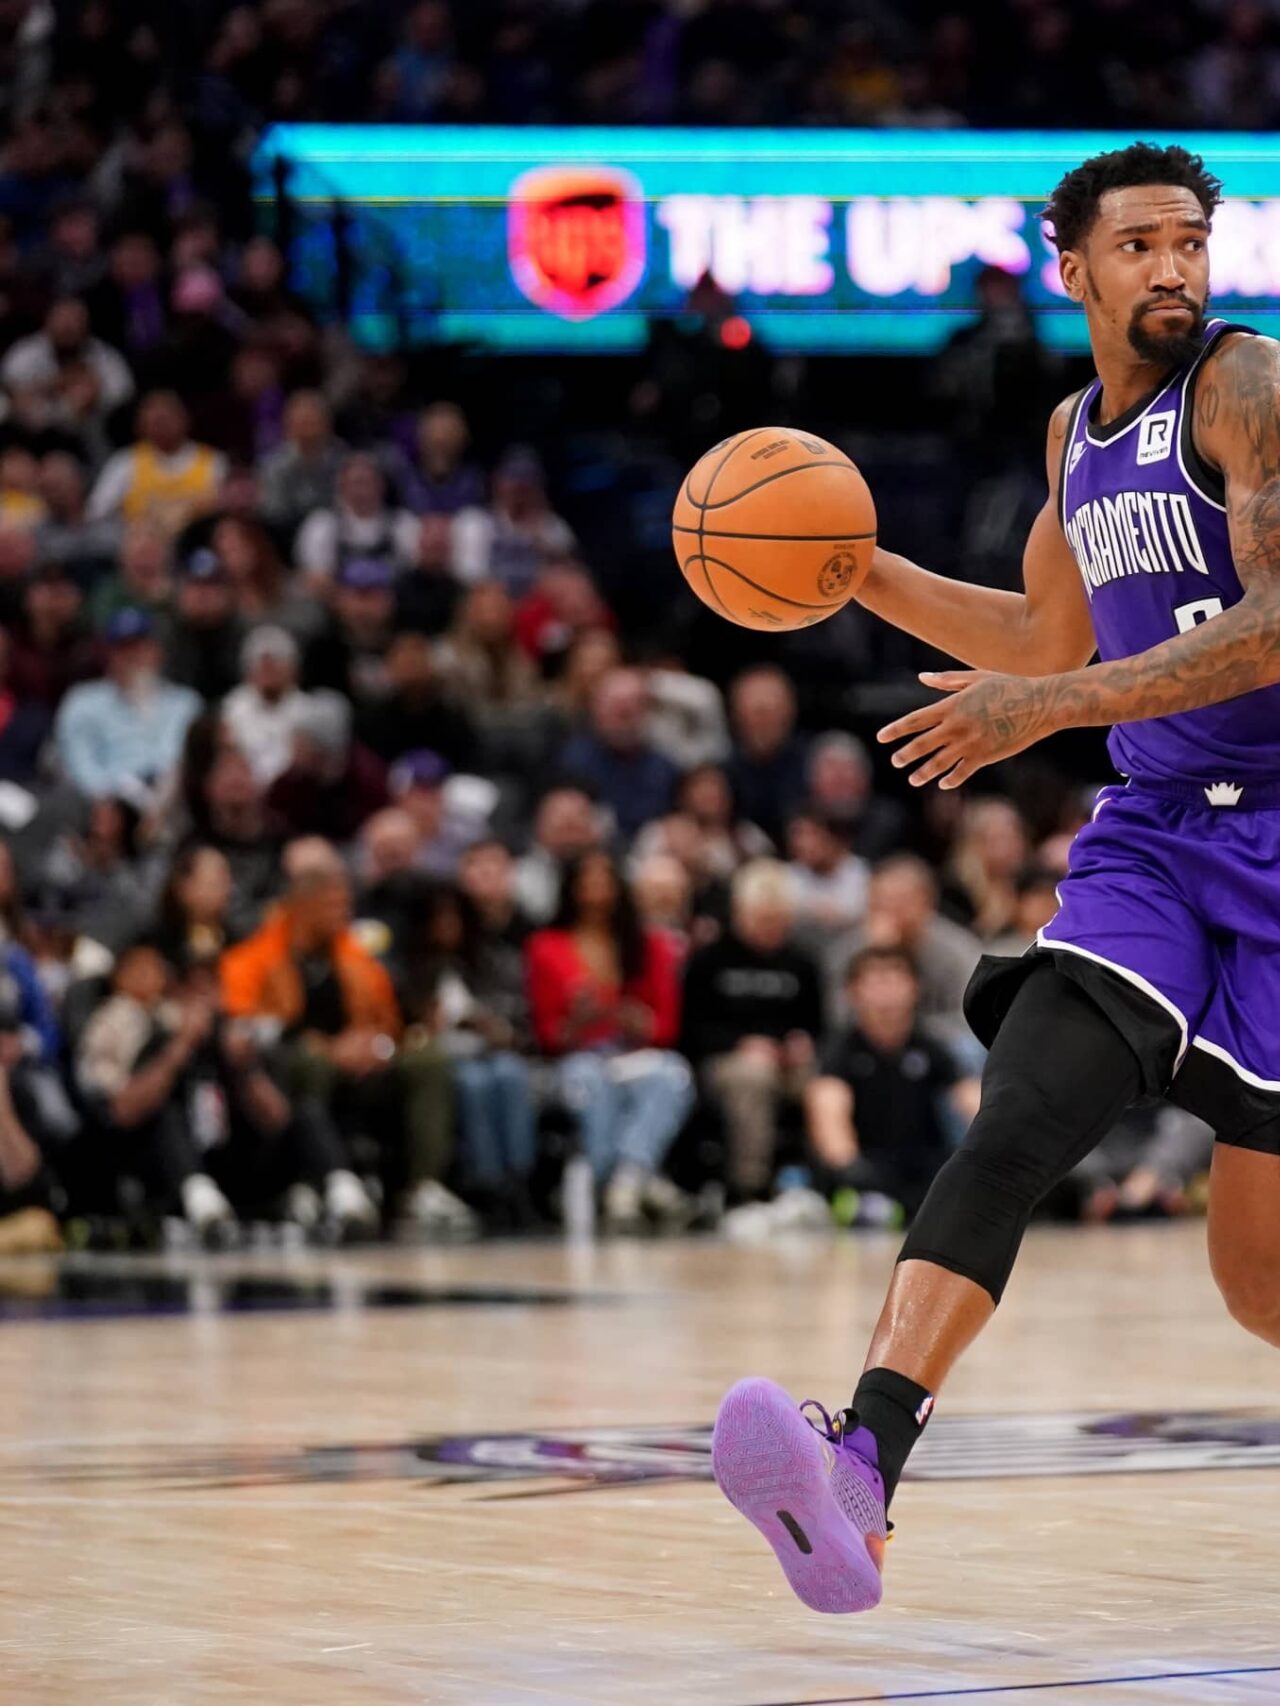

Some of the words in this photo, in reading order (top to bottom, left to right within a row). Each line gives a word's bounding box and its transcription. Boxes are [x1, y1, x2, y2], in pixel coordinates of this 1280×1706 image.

[656, 193, 834, 295] THE
[846, 195, 1031, 296] UPS
[1147, 419, 1168, 445] R
